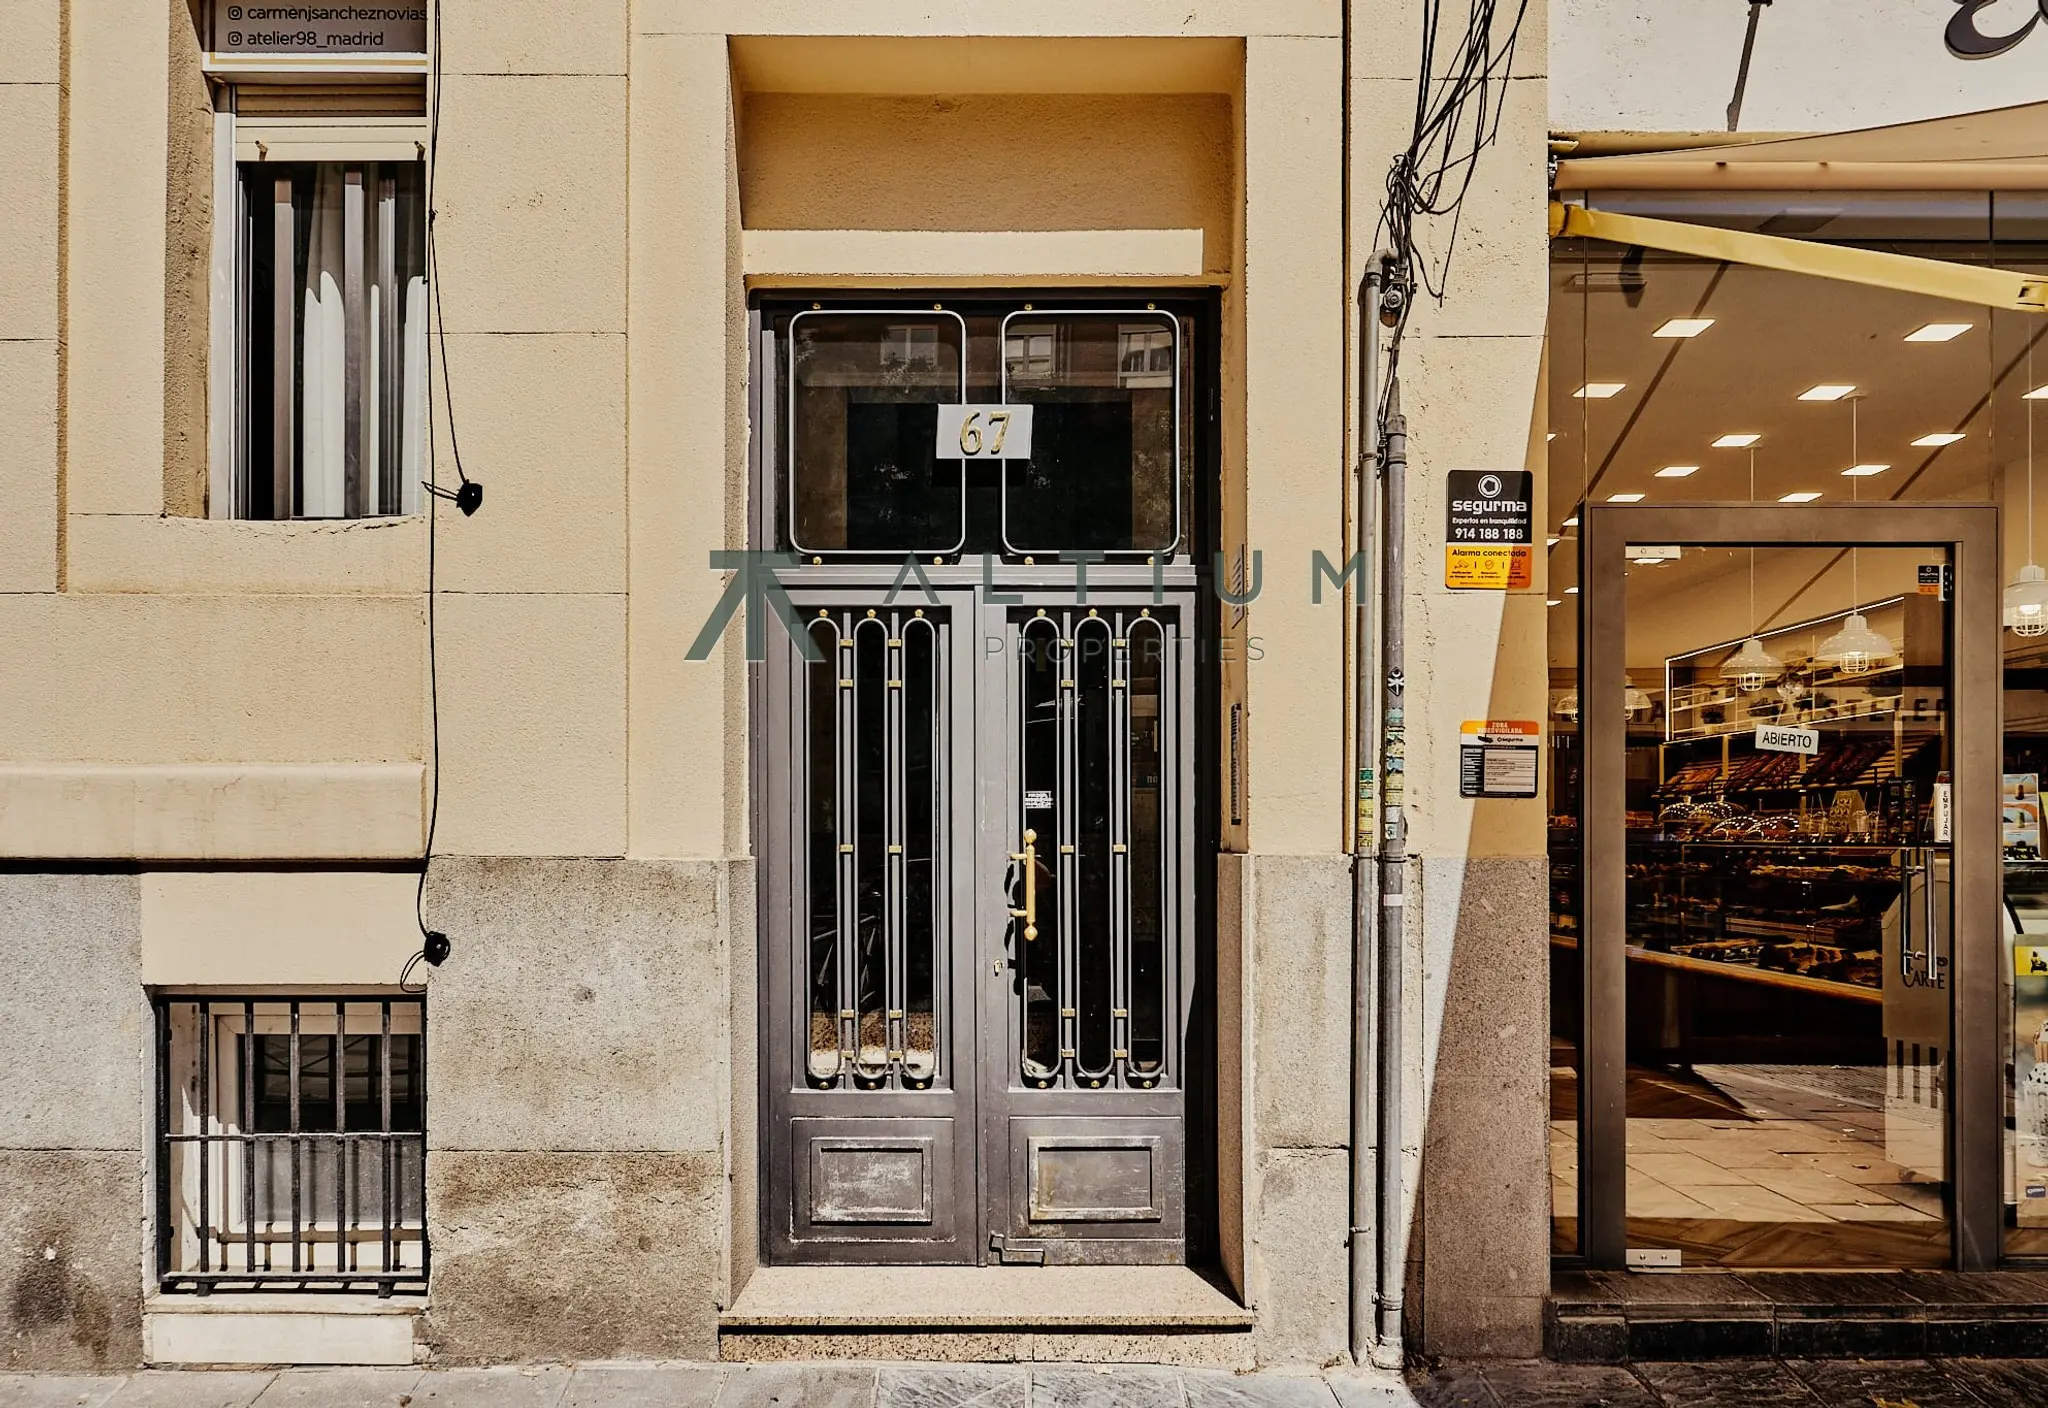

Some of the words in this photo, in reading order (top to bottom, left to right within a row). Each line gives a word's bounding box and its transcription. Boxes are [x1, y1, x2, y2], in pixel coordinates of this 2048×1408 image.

[247, 6, 428, 21] carmenjsancheznovias
[247, 31, 384, 48] atelier98_madrid
[960, 408, 1011, 456] 67
[1452, 500, 1527, 515] segurma
[1455, 528, 1476, 539] 914
[1479, 528, 1499, 539] 188
[1503, 528, 1524, 539] 188
[1762, 731, 1812, 748] ABIERTO
